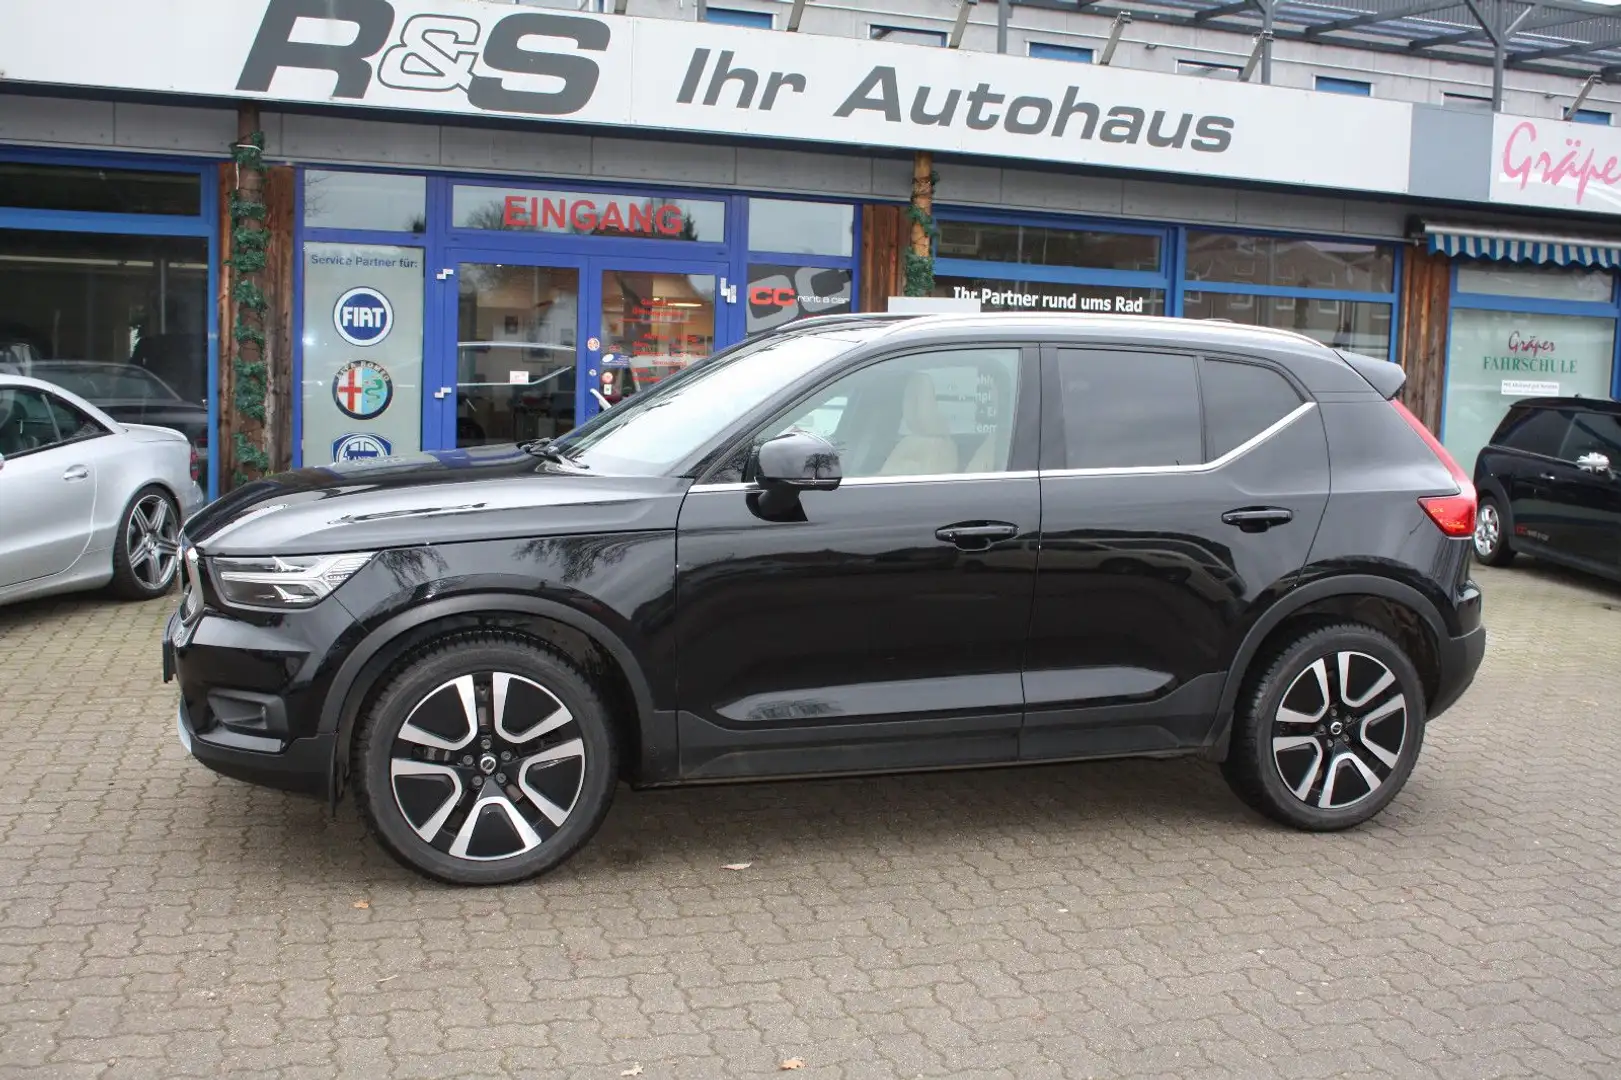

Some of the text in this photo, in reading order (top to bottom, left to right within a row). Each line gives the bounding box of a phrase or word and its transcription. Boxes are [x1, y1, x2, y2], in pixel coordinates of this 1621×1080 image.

[235, 0, 611, 115] R&S
[676, 48, 1236, 154] Ihr Autohaus
[503, 195, 684, 235] EINGANG
[311, 254, 353, 266] Service
[355, 256, 397, 267] Partner
[797, 294, 821, 304] rent
[953, 286, 1144, 313] Ihr Partner rund ums Rad
[342, 306, 385, 328] FIAT
[1483, 356, 1578, 374] FAHRSCHULE
